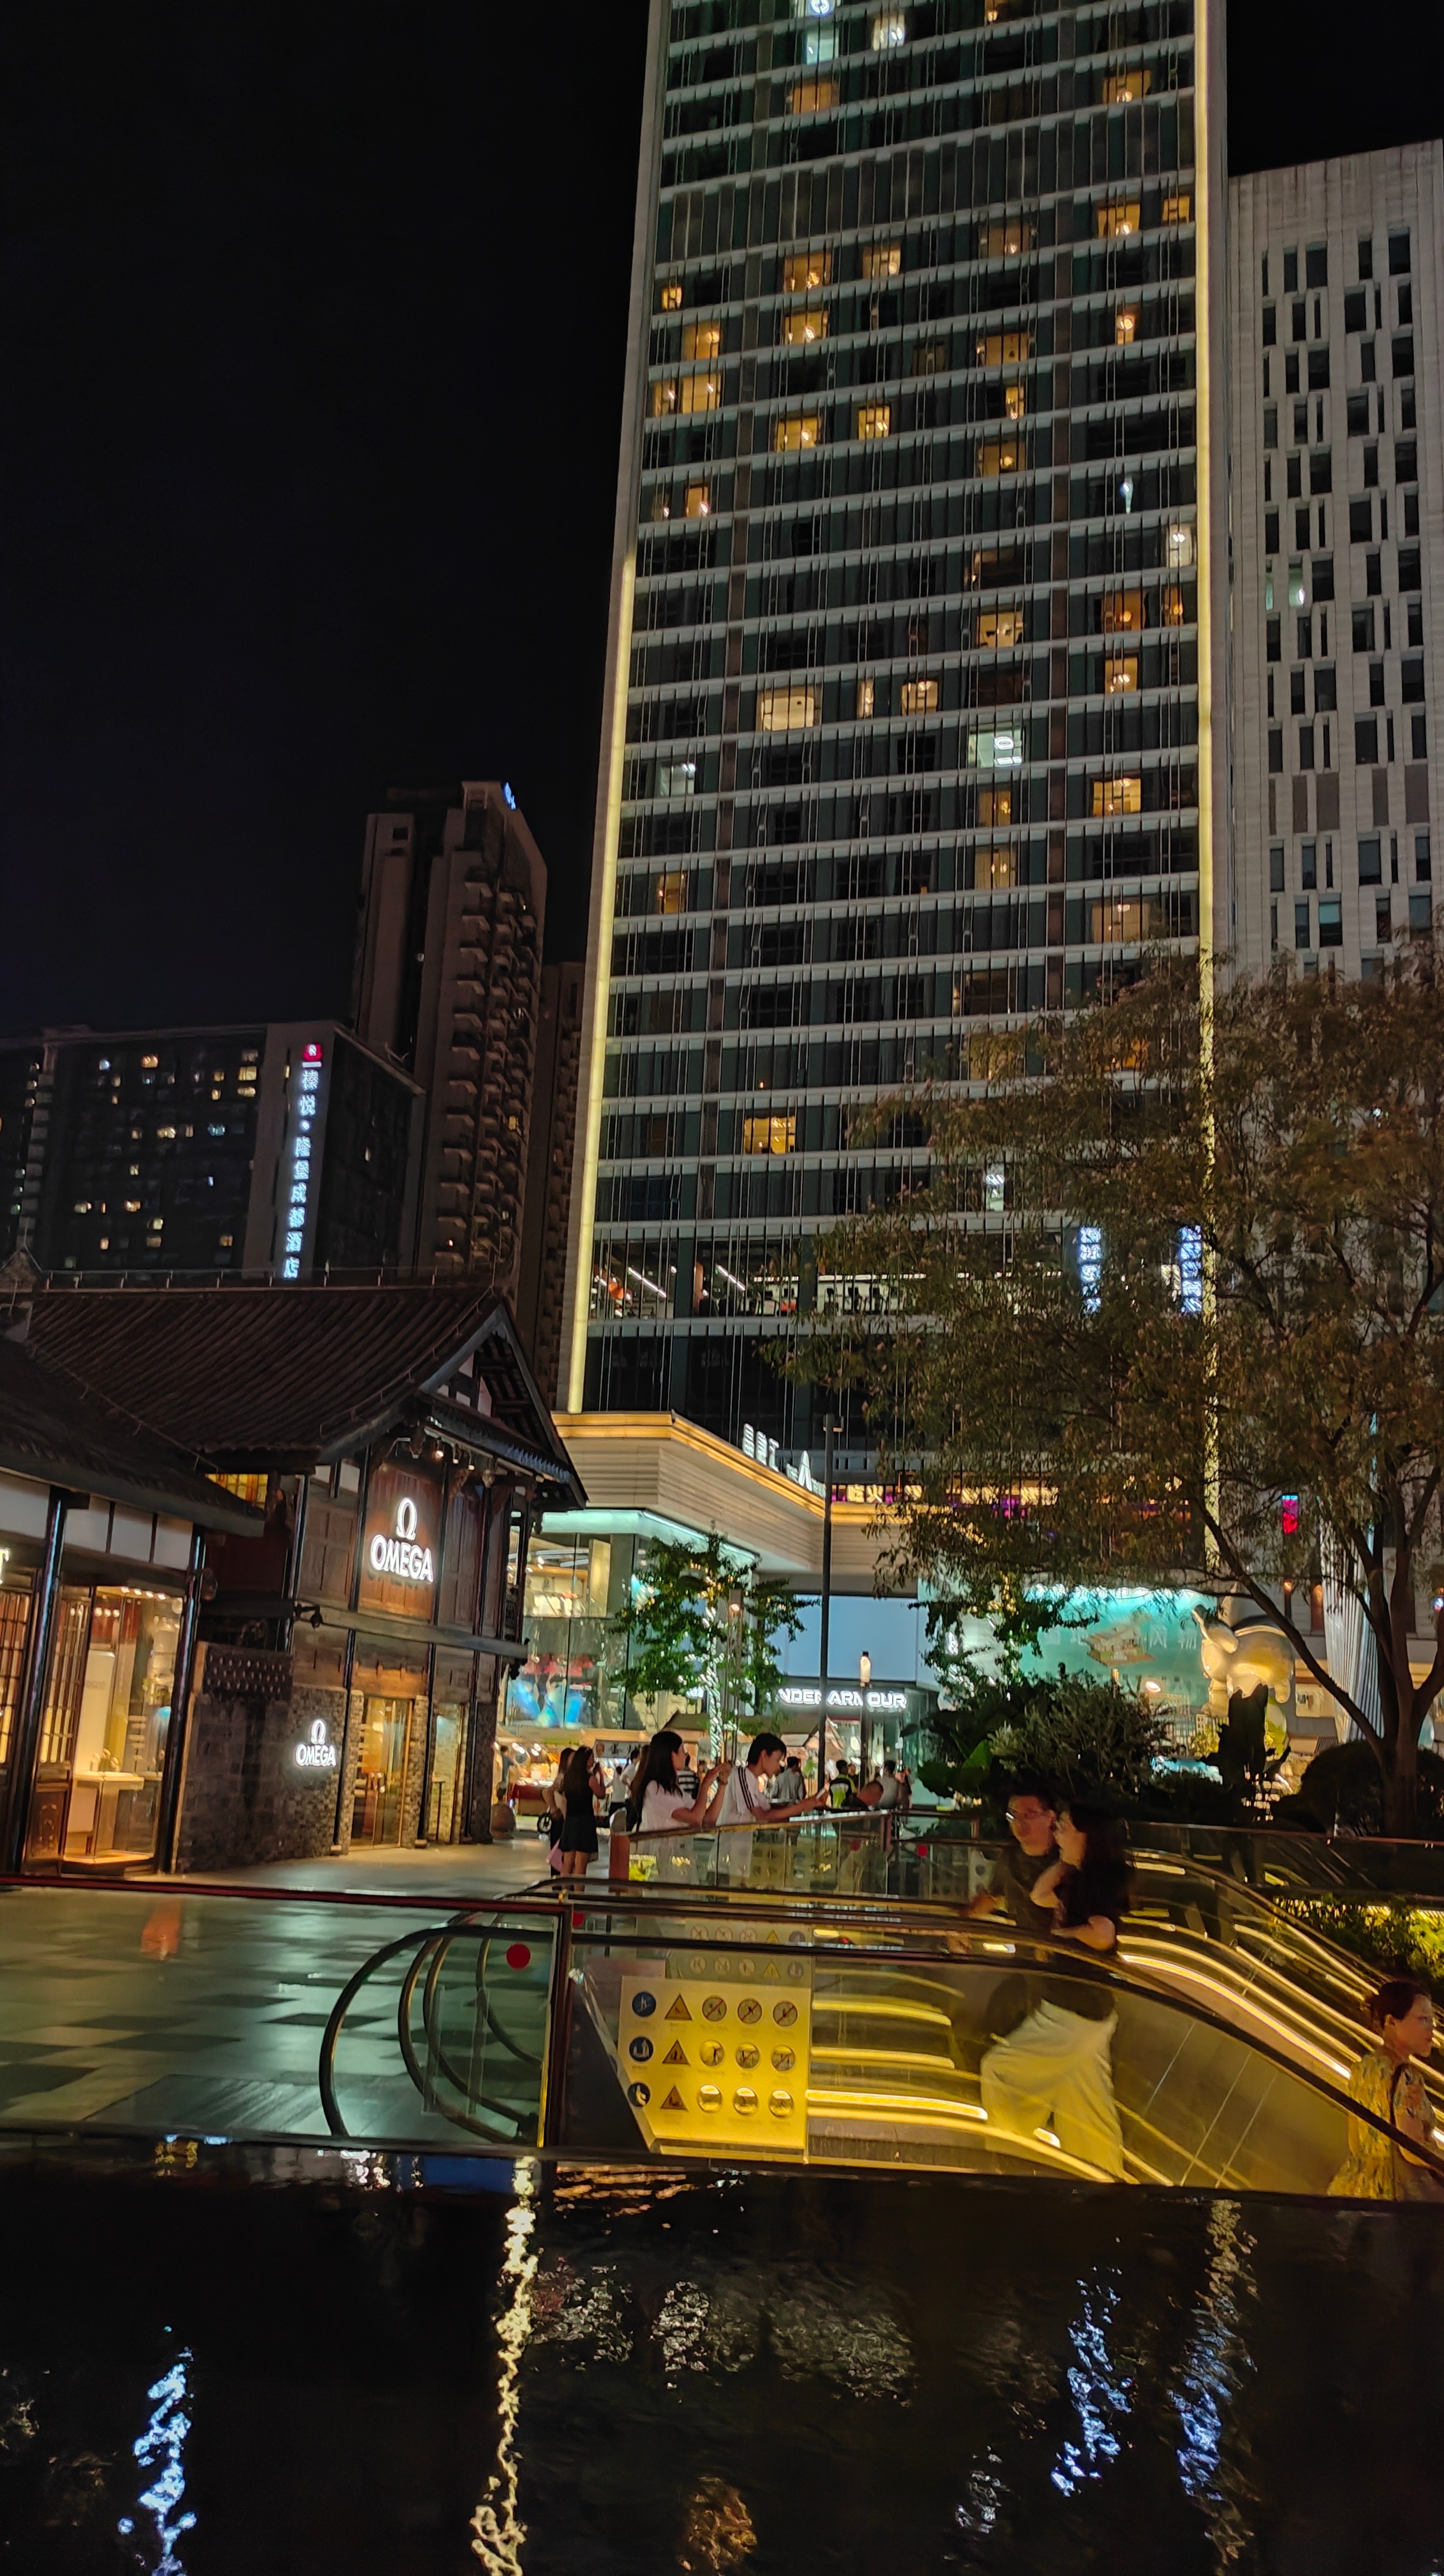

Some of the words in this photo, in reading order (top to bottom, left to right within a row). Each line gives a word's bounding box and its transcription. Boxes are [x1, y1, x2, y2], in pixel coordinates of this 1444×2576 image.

[370, 1534, 433, 1582] OMEGA
[773, 1688, 822, 1705] NDE
[296, 1744, 336, 1766] OMEGA
